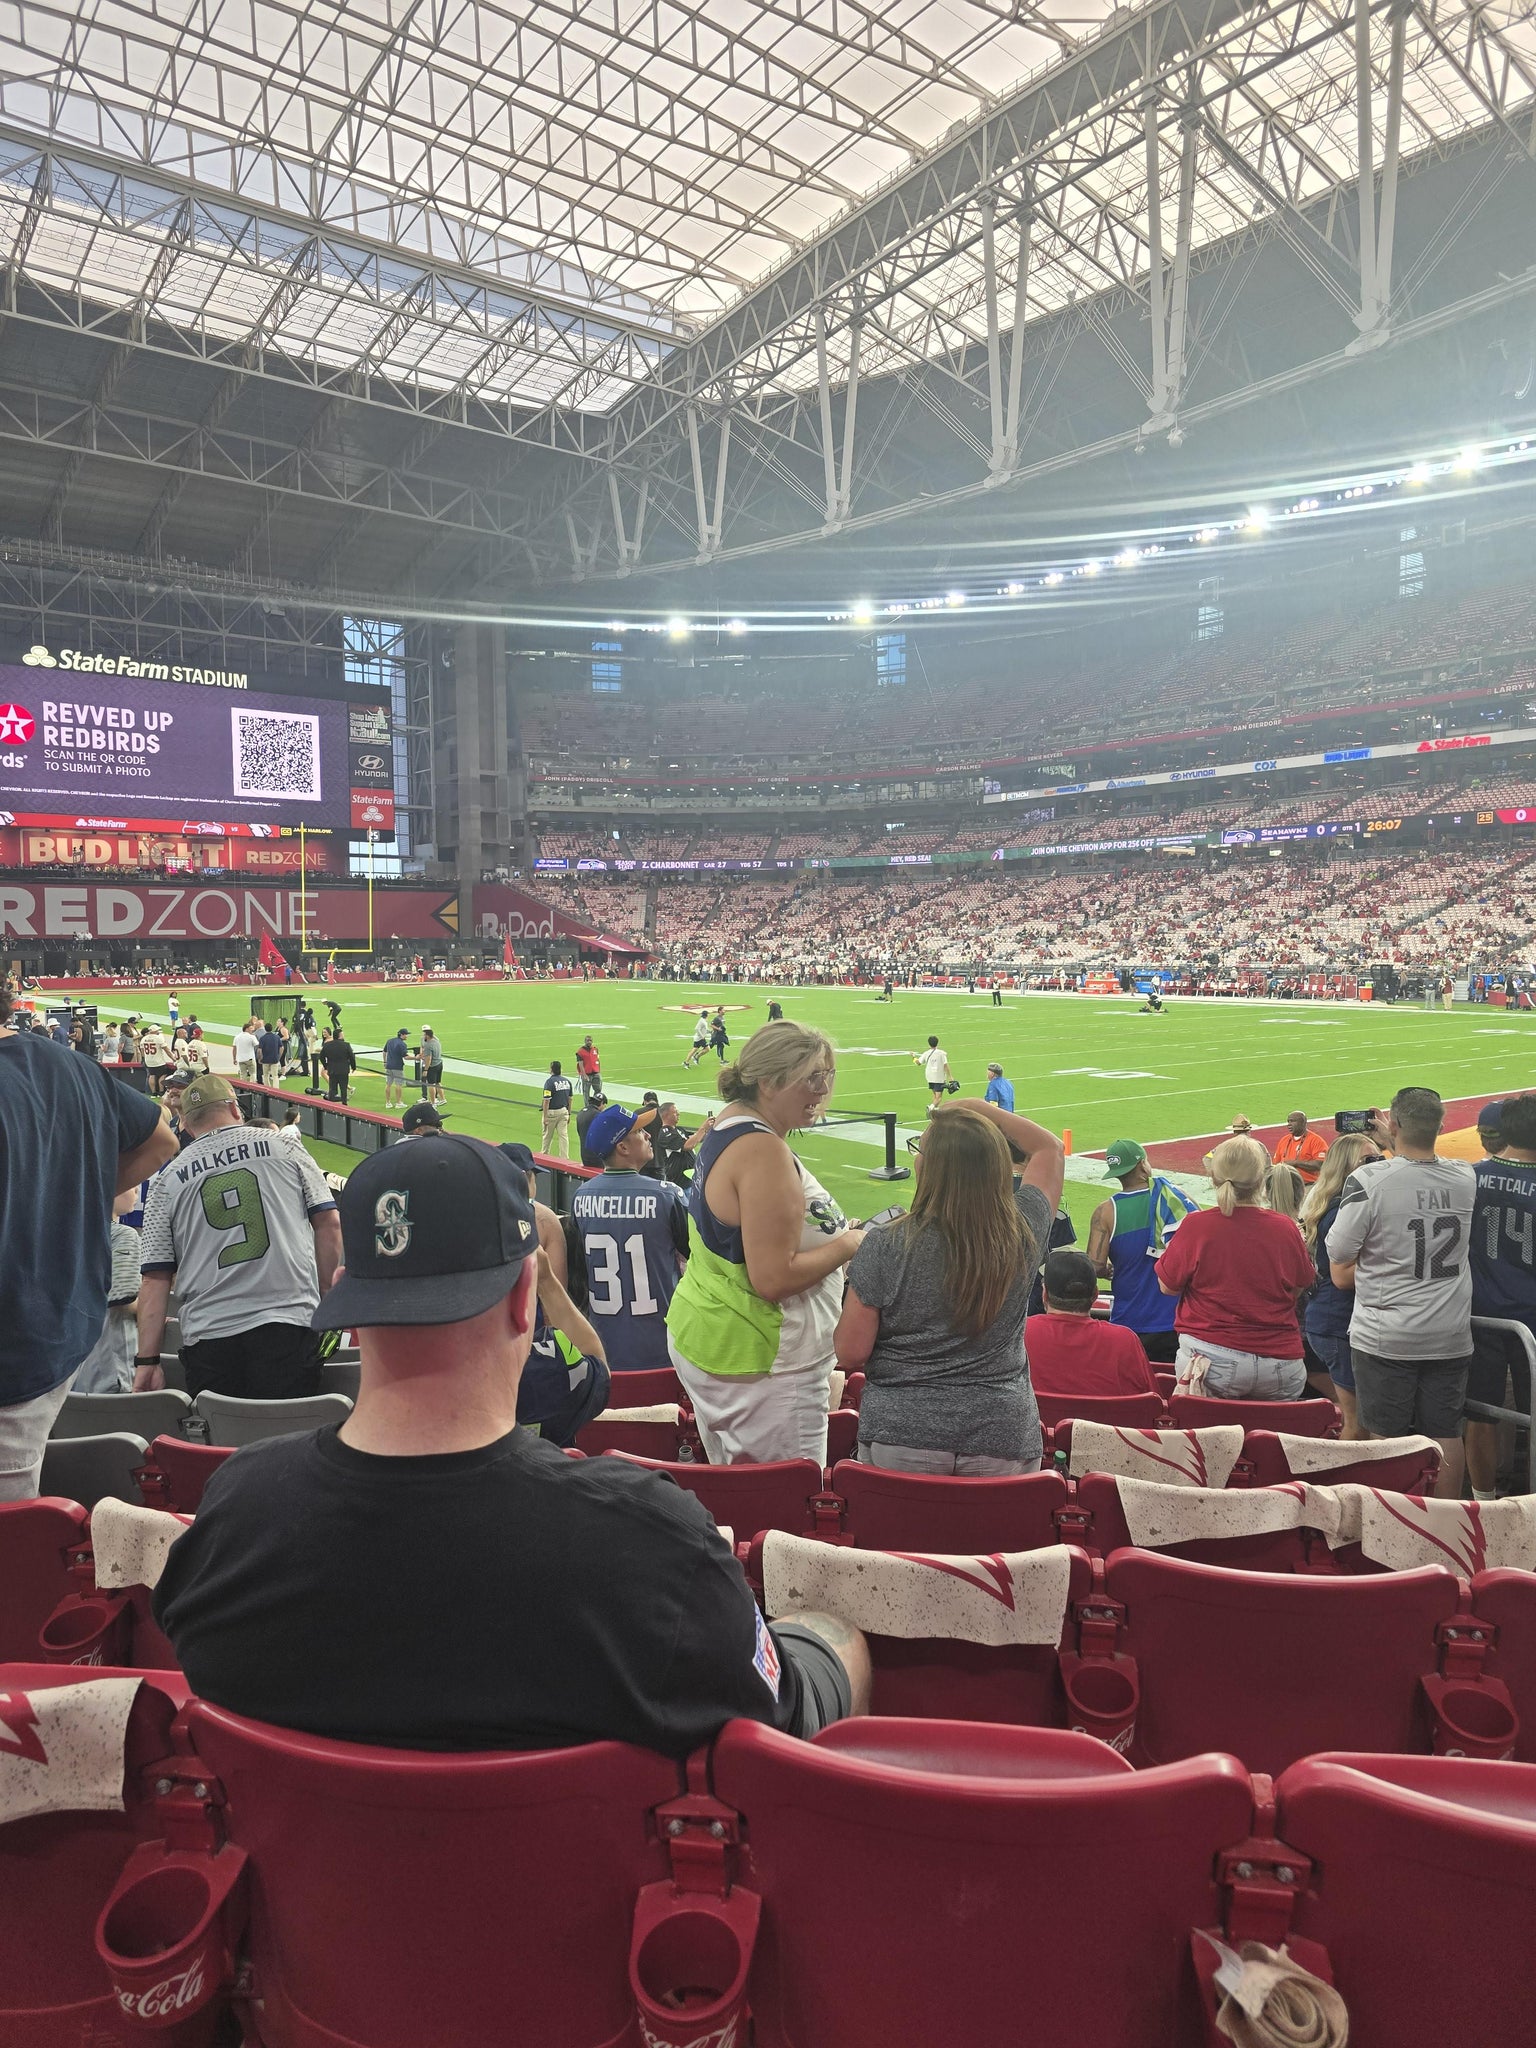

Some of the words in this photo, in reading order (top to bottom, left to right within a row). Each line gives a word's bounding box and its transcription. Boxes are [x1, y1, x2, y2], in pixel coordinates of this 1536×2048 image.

[172, 666, 248, 689] STADIUM
[1494, 684, 1524, 694] LARRY
[42, 701, 136, 729] REVVED
[144, 710, 174, 732] UP
[1233, 723, 1247, 731] DAN
[1248, 720, 1283, 729] DIERDORF
[43, 726, 161, 753] REDBIRDS
[44, 750, 75, 760] SCAN
[77, 752, 97, 762] THE
[99, 754, 115, 764] QR
[118, 755, 146, 765] CODE
[1254, 760, 1277, 771] COX
[44, 762, 59, 771] TO
[62, 763, 102, 774] SUBMIT
[105, 766, 113, 774] A
[115, 767, 151, 777] PHOTO
[354, 770, 388, 778] HYUNDAI
[1183, 769, 1216, 779] HYUNDAI
[1480, 814, 1492, 822] 25
[1515, 809, 1527, 821] 0
[1316, 825, 1325, 835] 0
[1355, 822, 1361, 832] 1
[1367, 819, 1402, 832] 26:07
[28, 836, 112, 864] BUD
[1031, 847, 1045, 856] JOIN
[1045, 846, 1055, 854] ON
[1056, 845, 1068, 853] THE
[1068, 843, 1099, 852] CHEVRON
[1099, 842, 1112, 850] APP
[1113, 841, 1127, 849] FOR
[1141, 839, 1154, 847] OFF
[650, 861, 699, 869] CHARBONNET
[0, 886, 321, 936] REDZONE
[167, 976, 228, 985] CARDINALS
[143, 1043, 157, 1055] 85
[176, 1143, 250, 1184] WALKER
[254, 1140, 271, 1157] III
[1478, 1174, 1536, 1197] METCALF
[574, 1195, 657, 1219] CHANCELLOR
[1416, 1189, 1451, 1209] FAN
[199, 1167, 271, 1270] 9
[1482, 1205, 1533, 1265] 14
[1407, 1215, 1461, 1280] 12
[584, 1232, 659, 1316] 31
